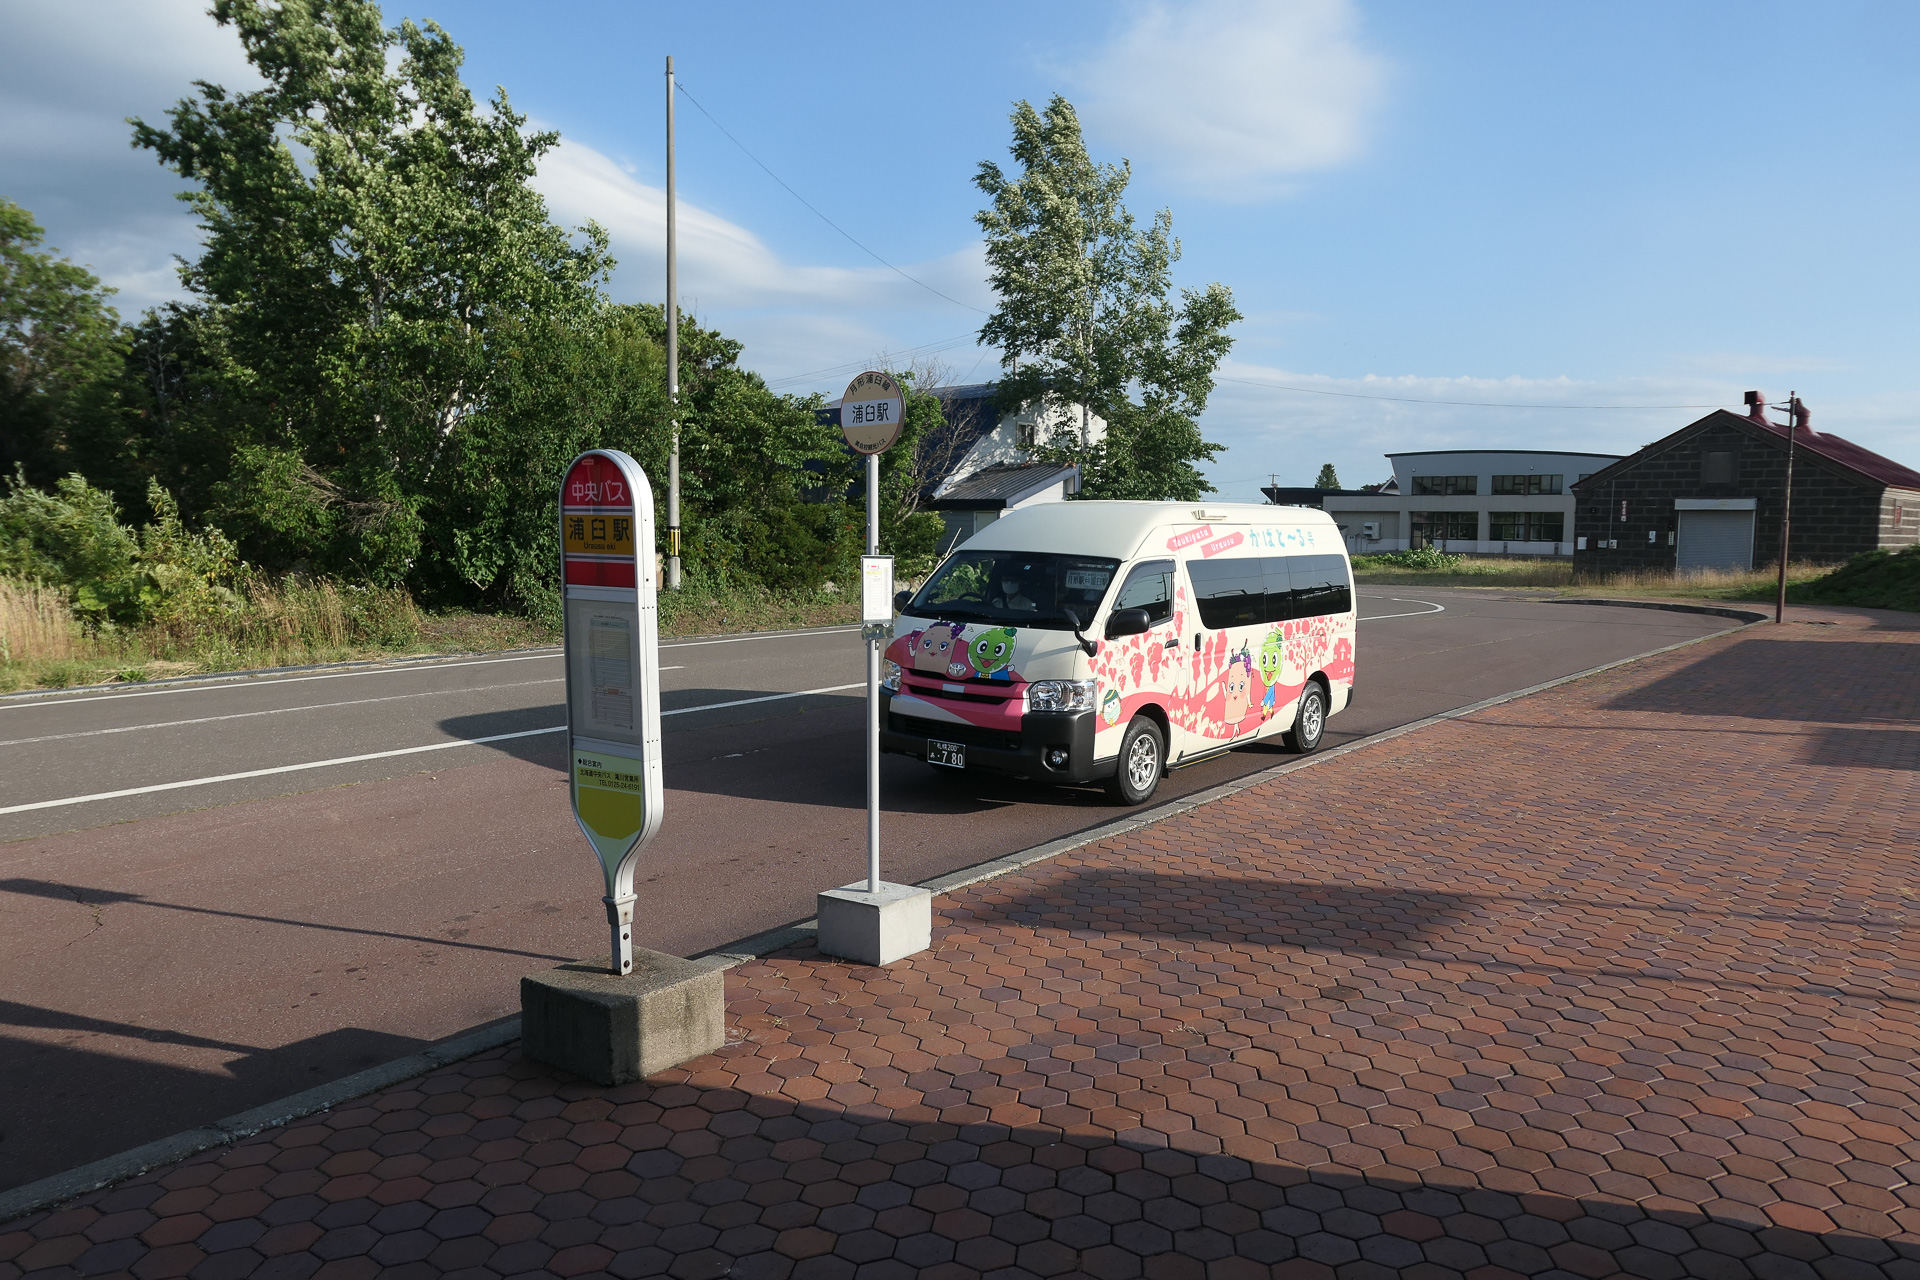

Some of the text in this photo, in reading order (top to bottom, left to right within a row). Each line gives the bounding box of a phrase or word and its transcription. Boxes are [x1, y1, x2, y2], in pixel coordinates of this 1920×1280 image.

[852, 402, 889, 424] 浦臼駅
[571, 480, 625, 502] 中央バス
[568, 517, 630, 541] 浦臼駅
[1172, 528, 1210, 548] Tsukigata
[583, 541, 616, 550] Urausu eki
[1210, 538, 1235, 552] Urausu
